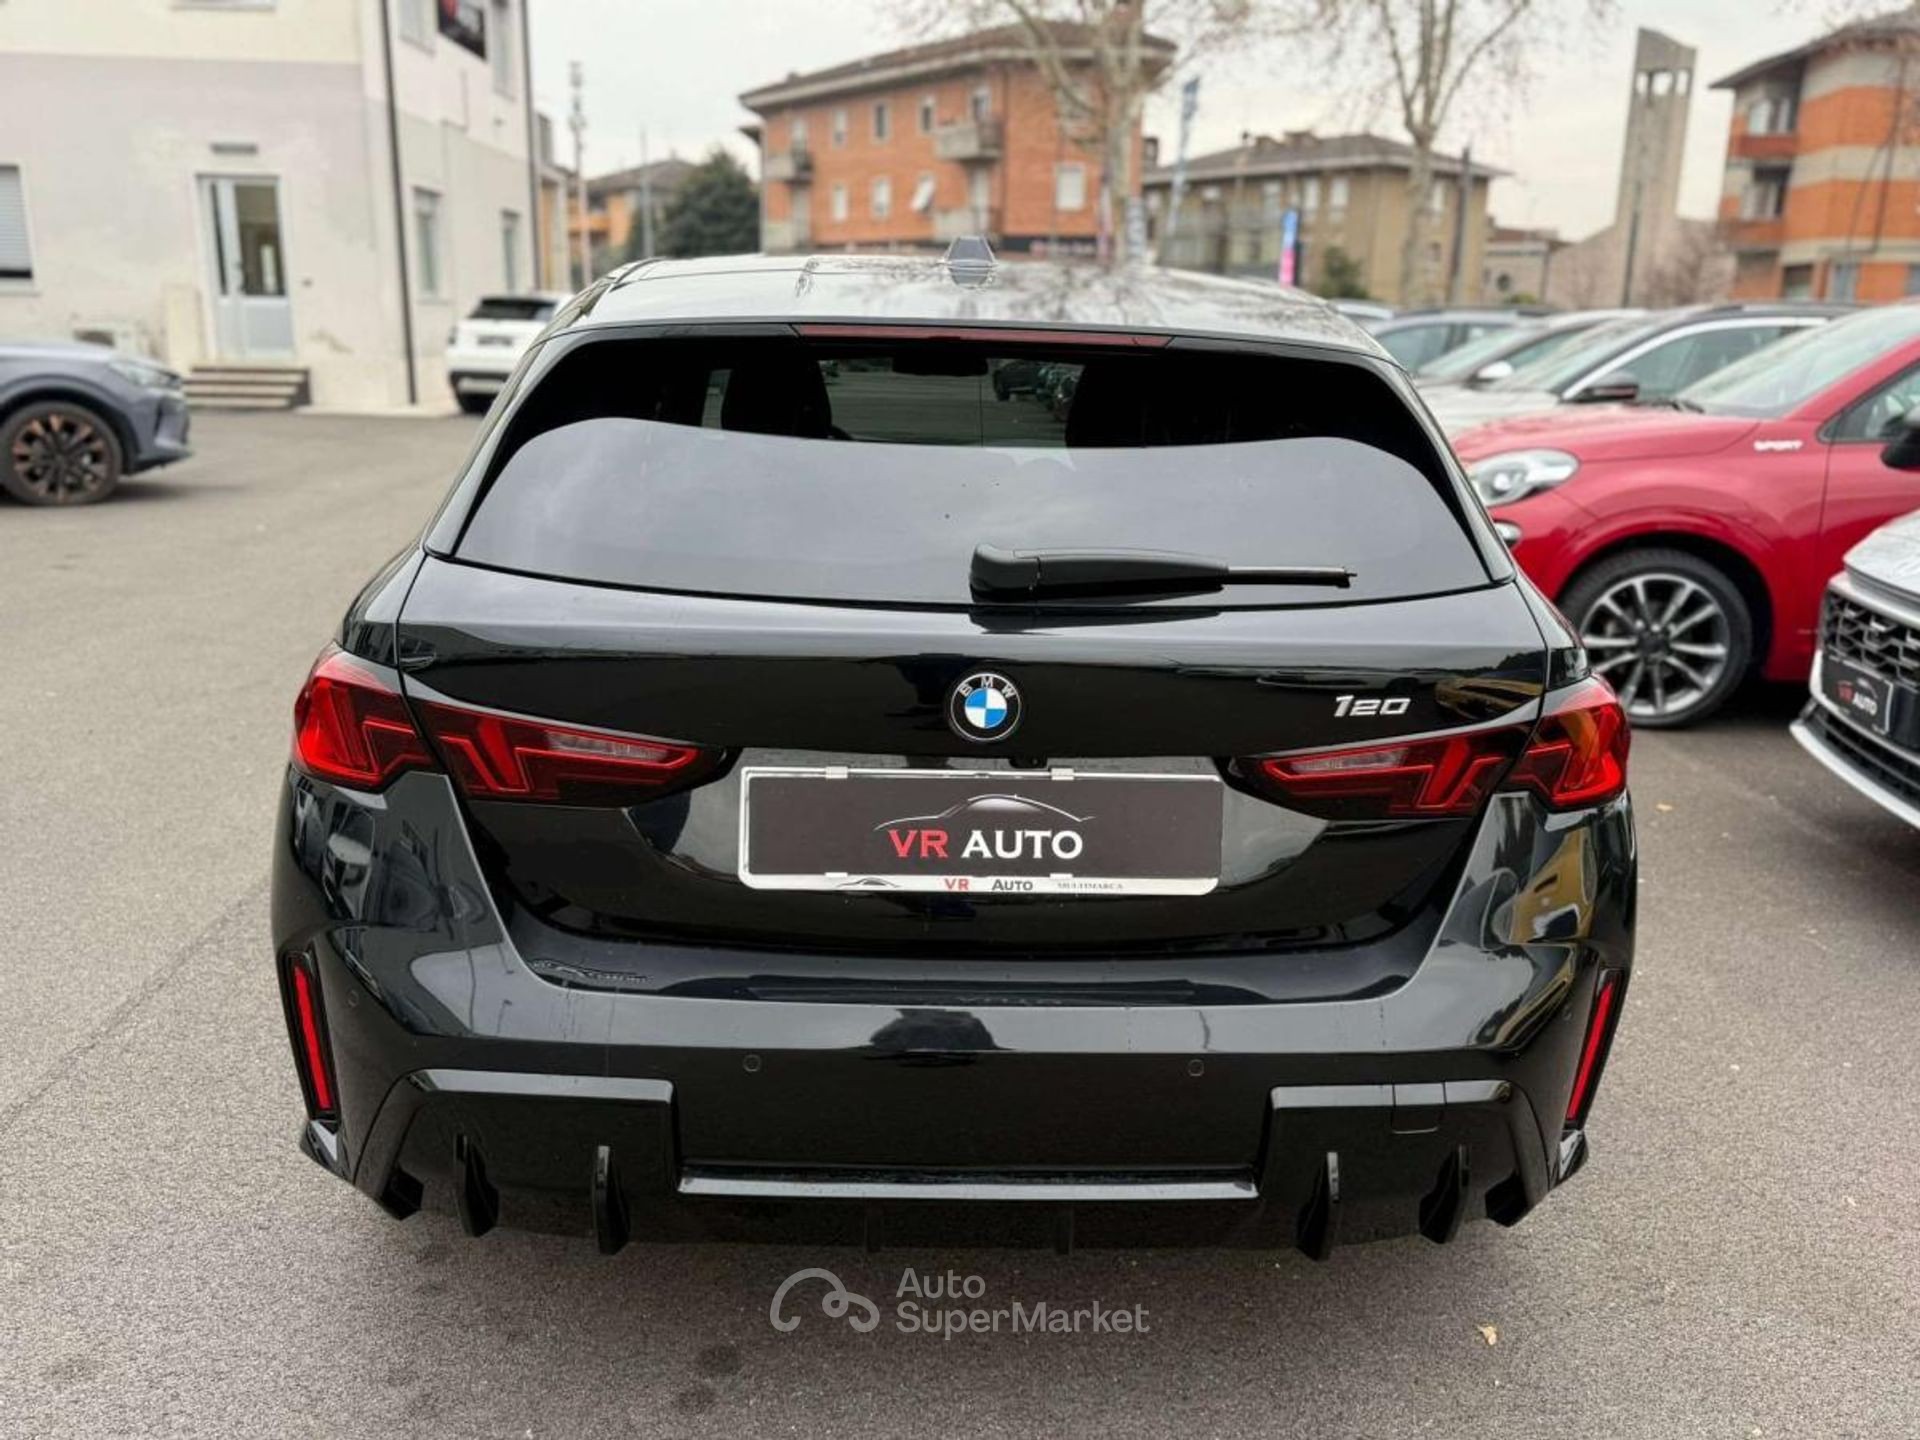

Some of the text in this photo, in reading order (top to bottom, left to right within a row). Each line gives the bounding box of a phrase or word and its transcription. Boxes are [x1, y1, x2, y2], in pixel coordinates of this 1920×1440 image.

[957, 675, 1017, 699] BMW
[1334, 694, 1411, 717] 120
[888, 829, 1084, 860] VR AUTO
[943, 877, 970, 891] VR
